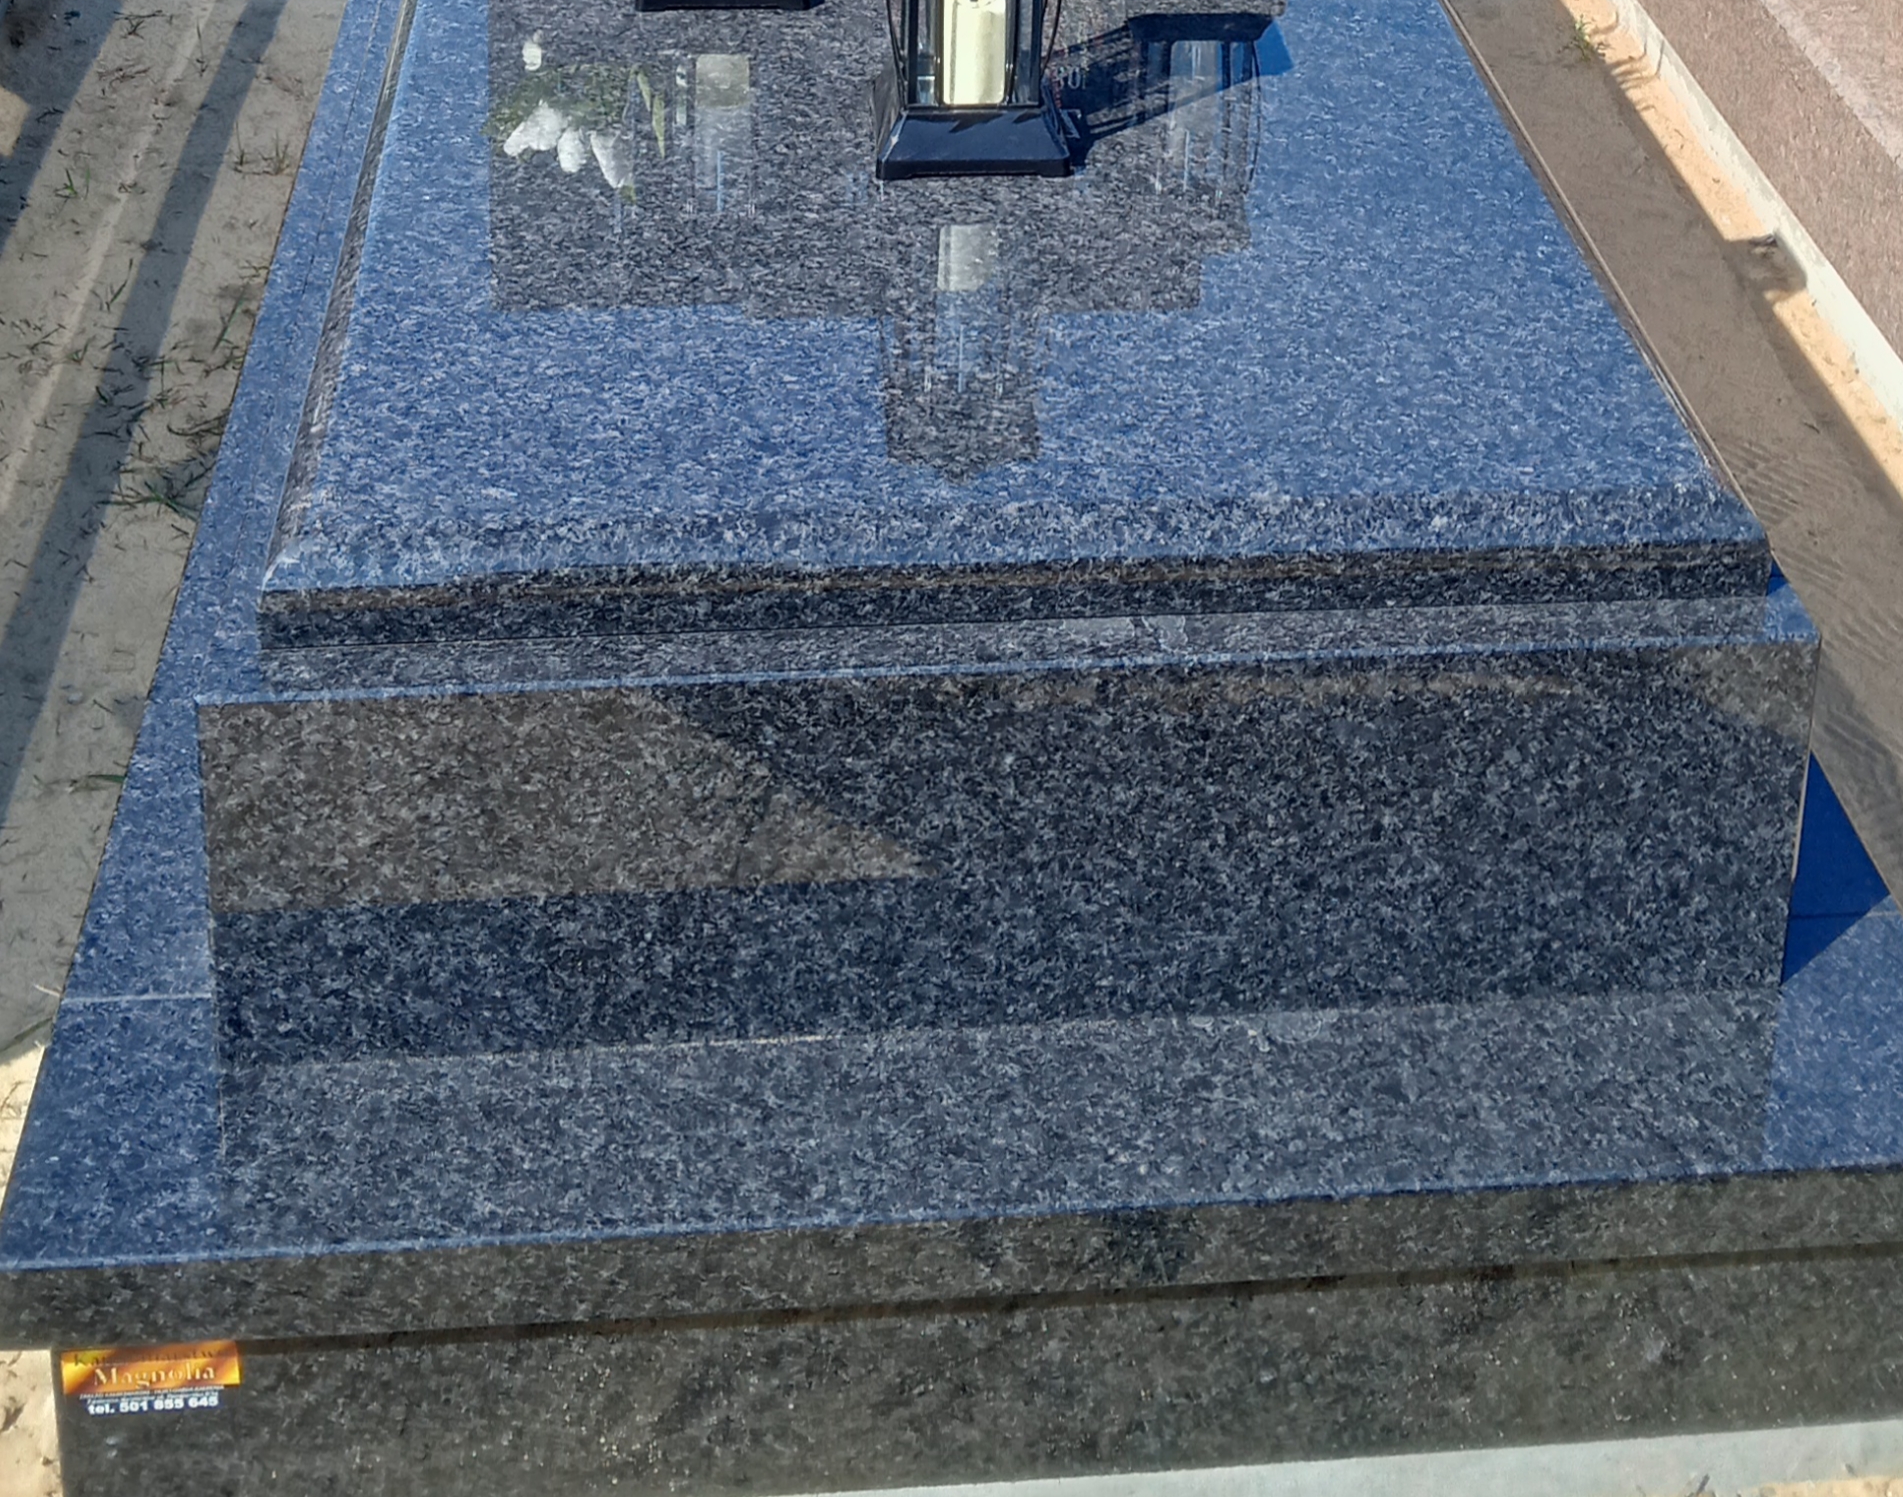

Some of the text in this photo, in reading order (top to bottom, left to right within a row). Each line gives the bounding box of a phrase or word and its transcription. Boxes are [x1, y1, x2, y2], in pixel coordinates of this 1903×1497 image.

[94, 1361, 215, 1390] Magnolia
[88, 1403, 115, 1415] tel.
[119, 1399, 148, 1413] 501
